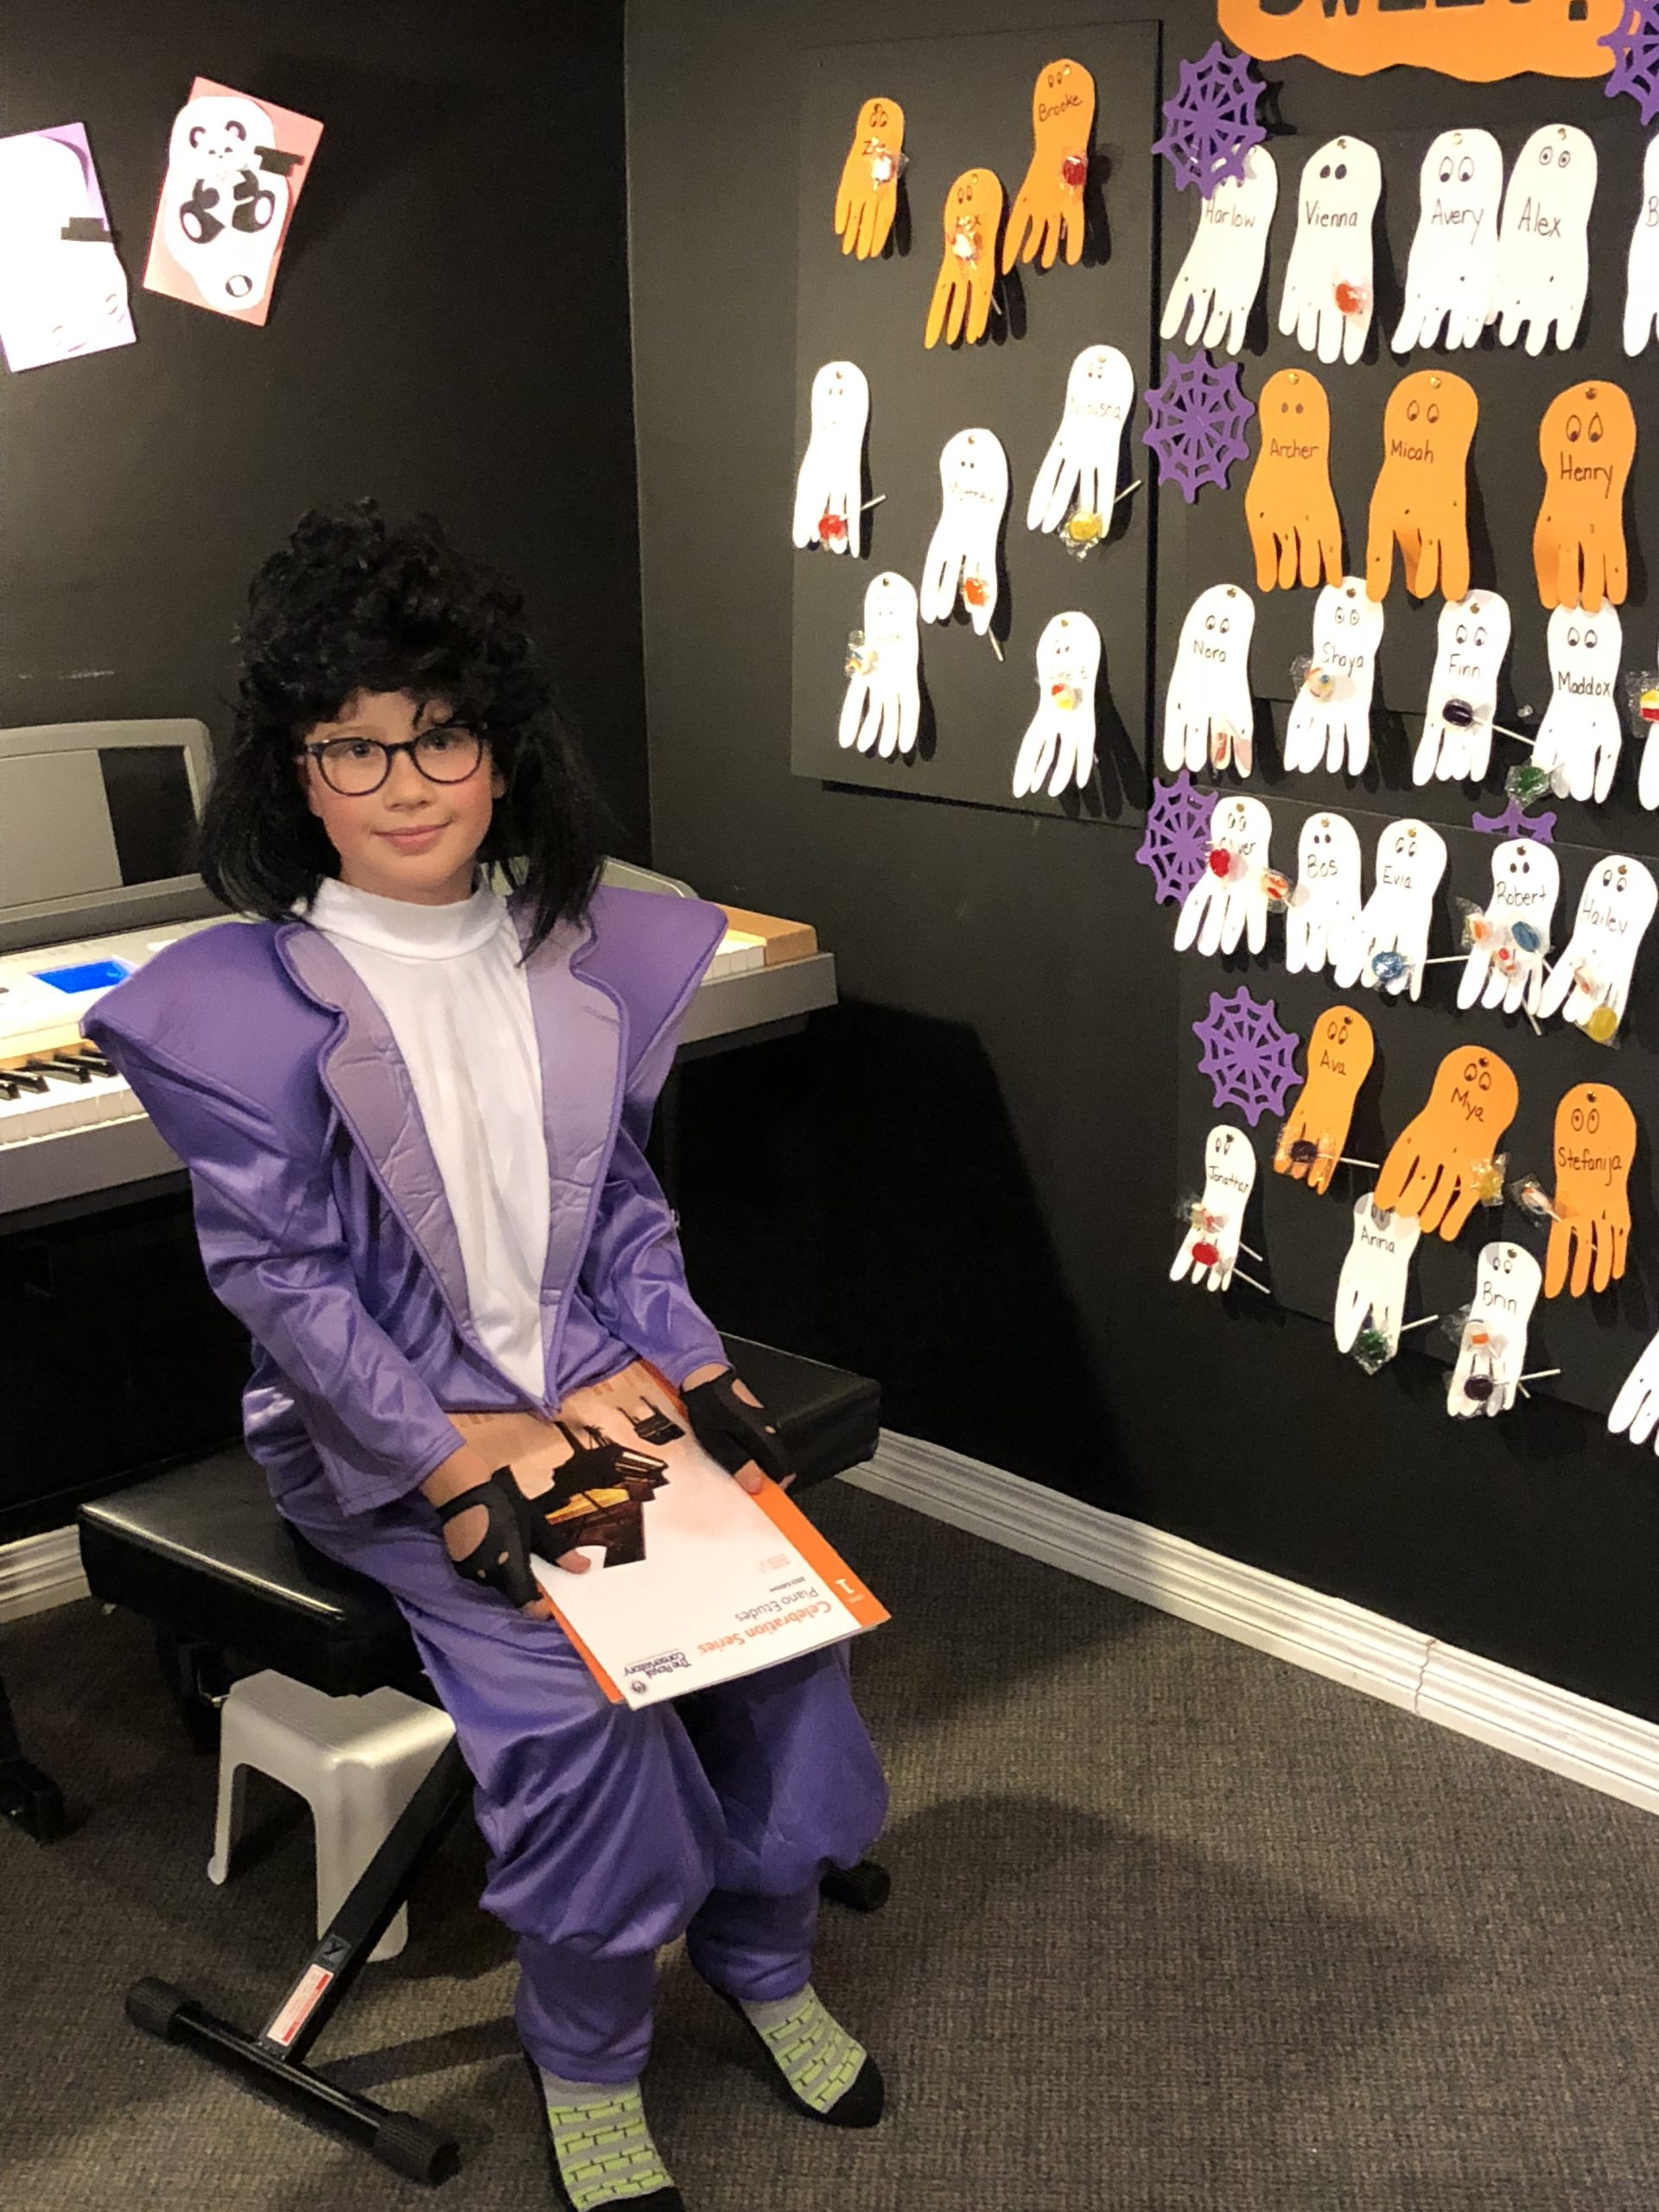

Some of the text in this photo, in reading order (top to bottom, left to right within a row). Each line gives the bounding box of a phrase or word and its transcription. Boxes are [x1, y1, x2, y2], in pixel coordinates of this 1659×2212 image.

[1039, 93, 1083, 122] Brooke
[1205, 196, 1255, 228] Harlow
[1306, 200, 1357, 227] Vienna
[1431, 198, 1484, 245] Avery
[1517, 196, 1561, 238] Alex
[1269, 437, 1319, 459] Archer
[1390, 439, 1434, 463] Micah
[1560, 450, 1614, 499] Henry
[1193, 639, 1226, 662] Nora
[1321, 642, 1364, 677] Shaya
[1448, 653, 1480, 677] Finn
[1558, 671, 1611, 696] Maddox
[1497, 881, 1547, 906] Robert
[1582, 895, 1628, 934] Hailey
[1319, 1049, 1346, 1076] Ava
[1451, 1087, 1485, 1122] Mya
[1558, 1146, 1623, 1186] Stefanija
[1361, 1224, 1395, 1254] Anna
[835, 1578, 855, 1594] 1
[734, 1586, 819, 1622] Piano Etudes
[745, 1600, 832, 1637] Celebration
[645, 1658, 691, 1678] The Royal
